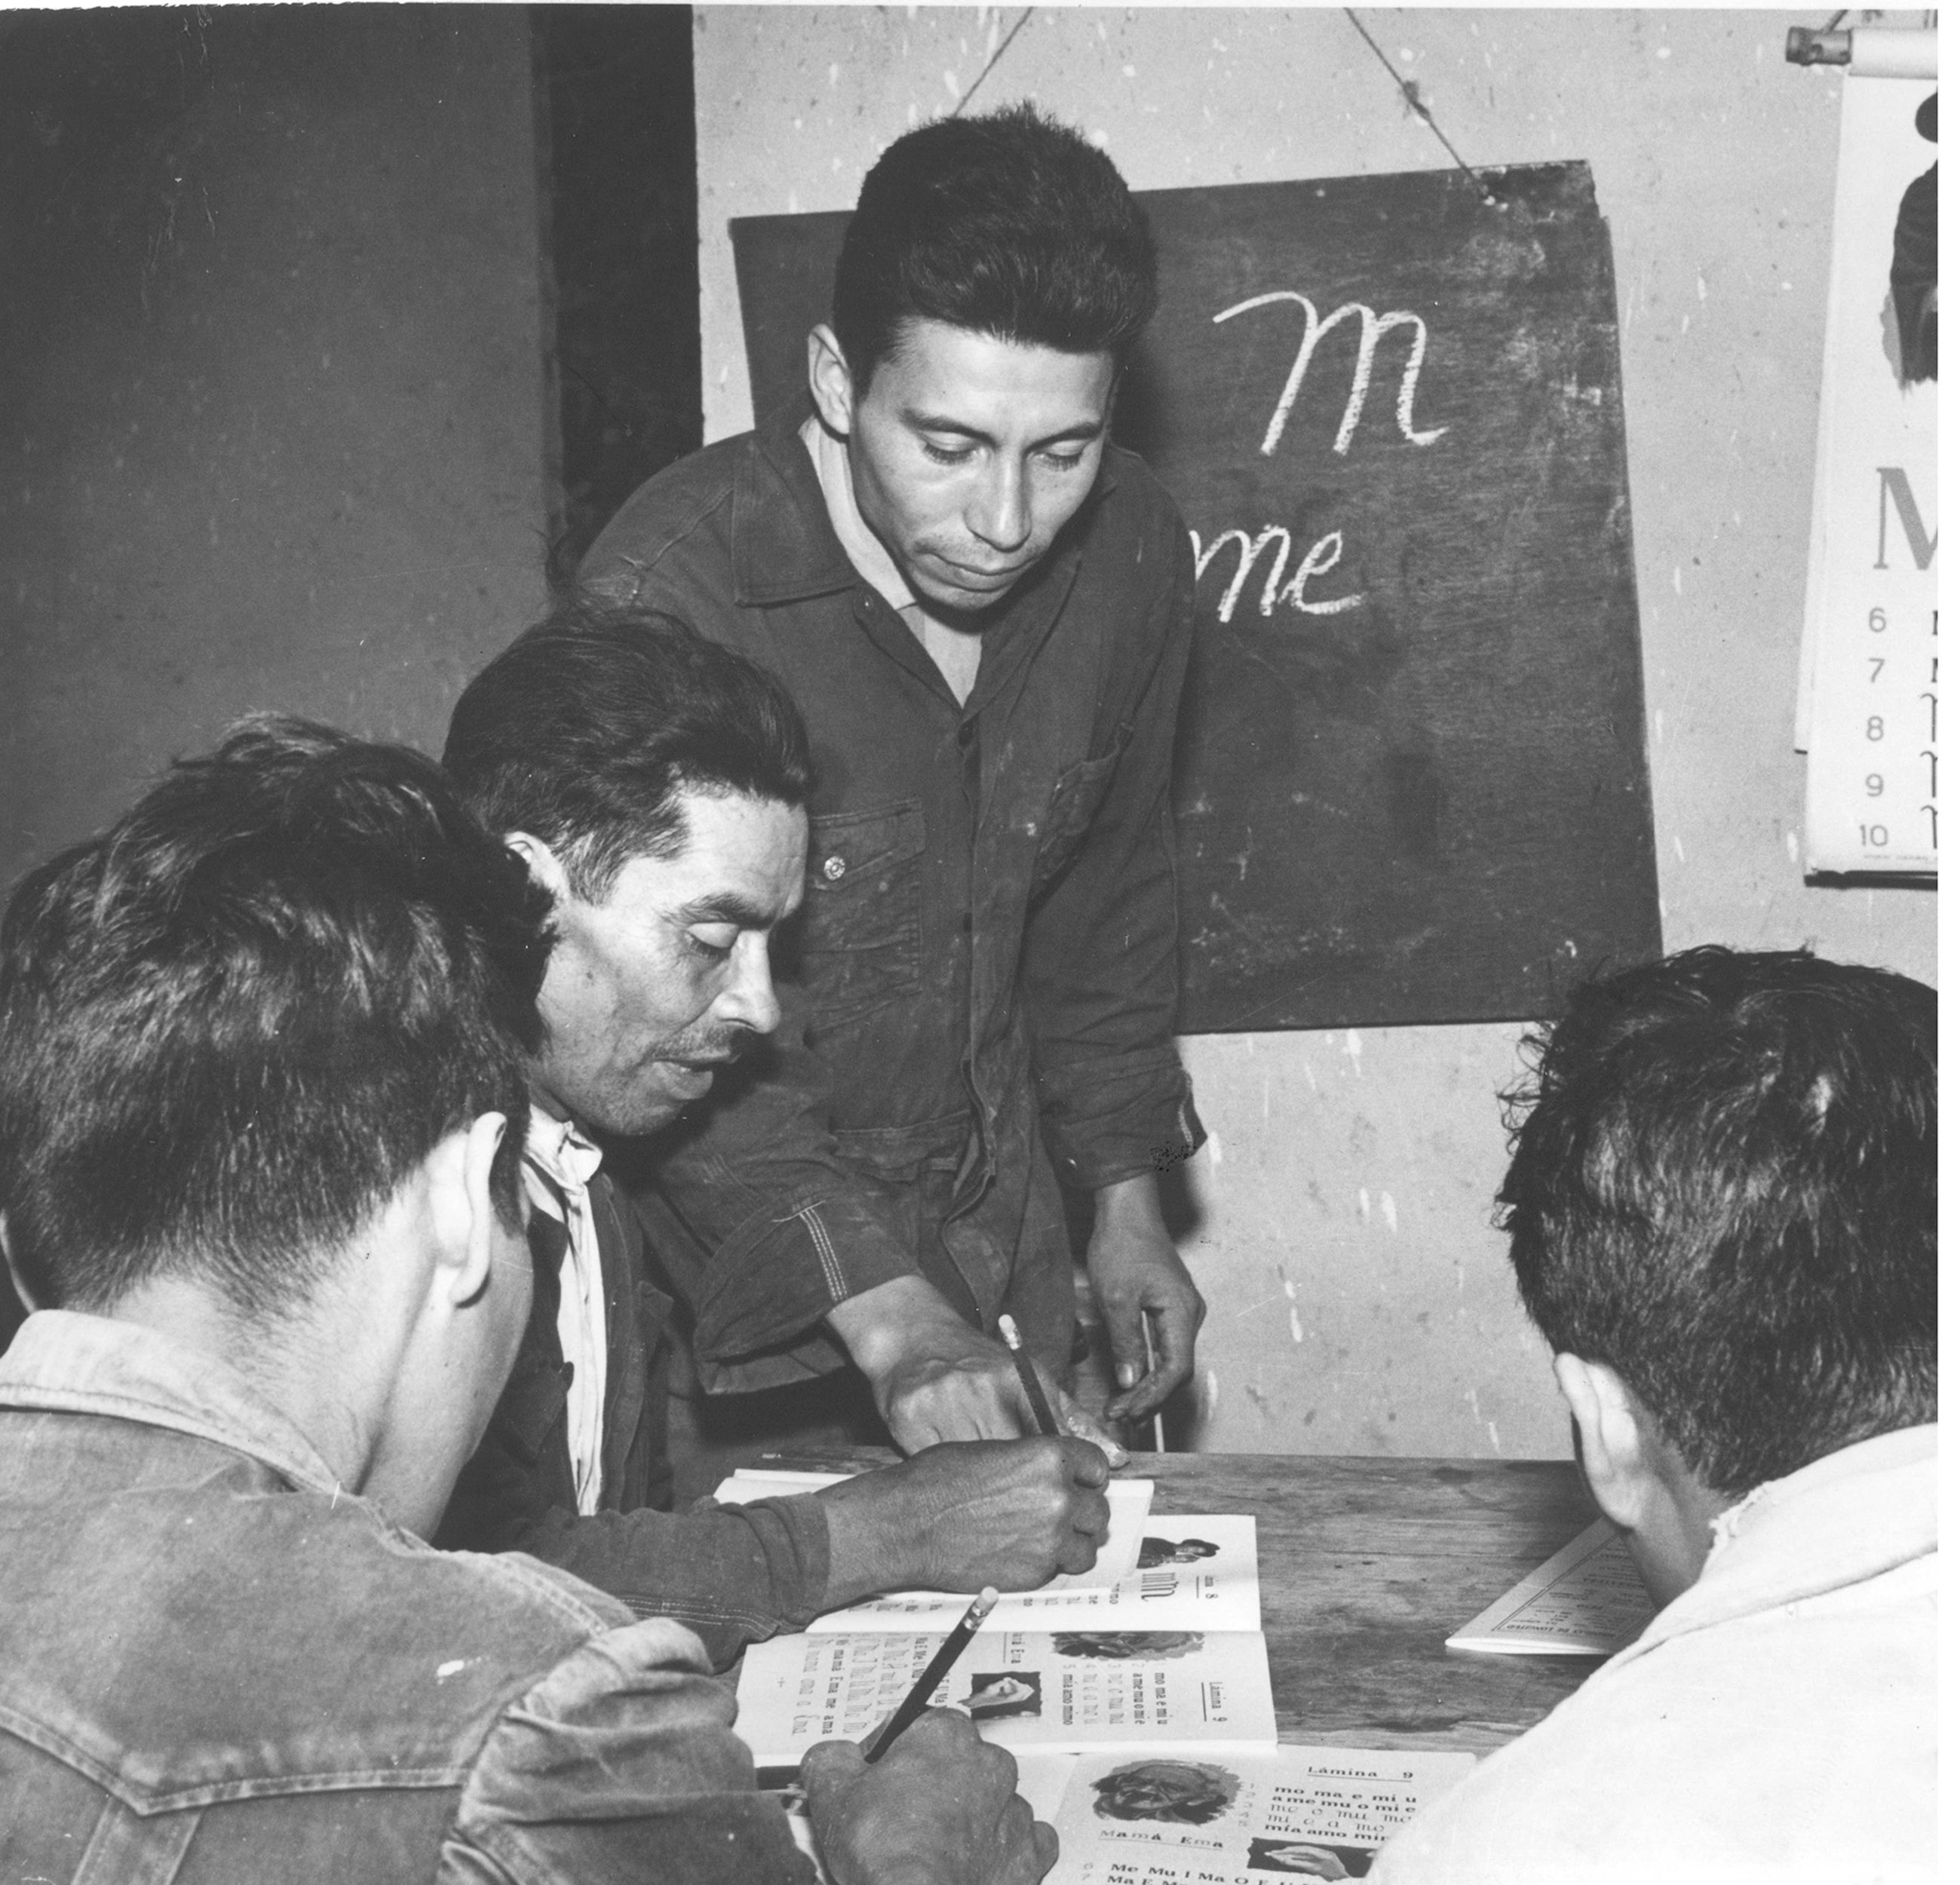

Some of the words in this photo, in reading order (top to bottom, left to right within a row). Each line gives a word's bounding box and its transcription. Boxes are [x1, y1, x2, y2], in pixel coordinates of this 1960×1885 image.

[1189, 525, 1368, 622] me
[1869, 608, 1886, 633] 6
[1869, 658, 1885, 683] 7
[1866, 716, 1884, 741] 8
[1866, 774, 1883, 798] 9
[1860, 825, 1888, 847] 10
[1209, 1681, 1226, 1709] Lámina
[1308, 1766, 1378, 1778] Lámina
[1274, 1786, 1305, 1795] mo
[1314, 1790, 1343, 1798] ma
[1372, 1794, 1396, 1802] mi
[1320, 1800, 1351, 1808] mu
[1375, 1804, 1399, 1812] mi
[1100, 1829, 1162, 1841] Mamá
[1180, 1835, 1224, 1848] Ema
[1264, 1823, 1302, 1834] mía
[1306, 1830, 1347, 1838] amo
[1107, 1875, 1135, 1885] Ma
[1110, 1863, 1139, 1874] Me
[1148, 1867, 1176, 1877] Mu
[1198, 1872, 1226, 1883] Ma
